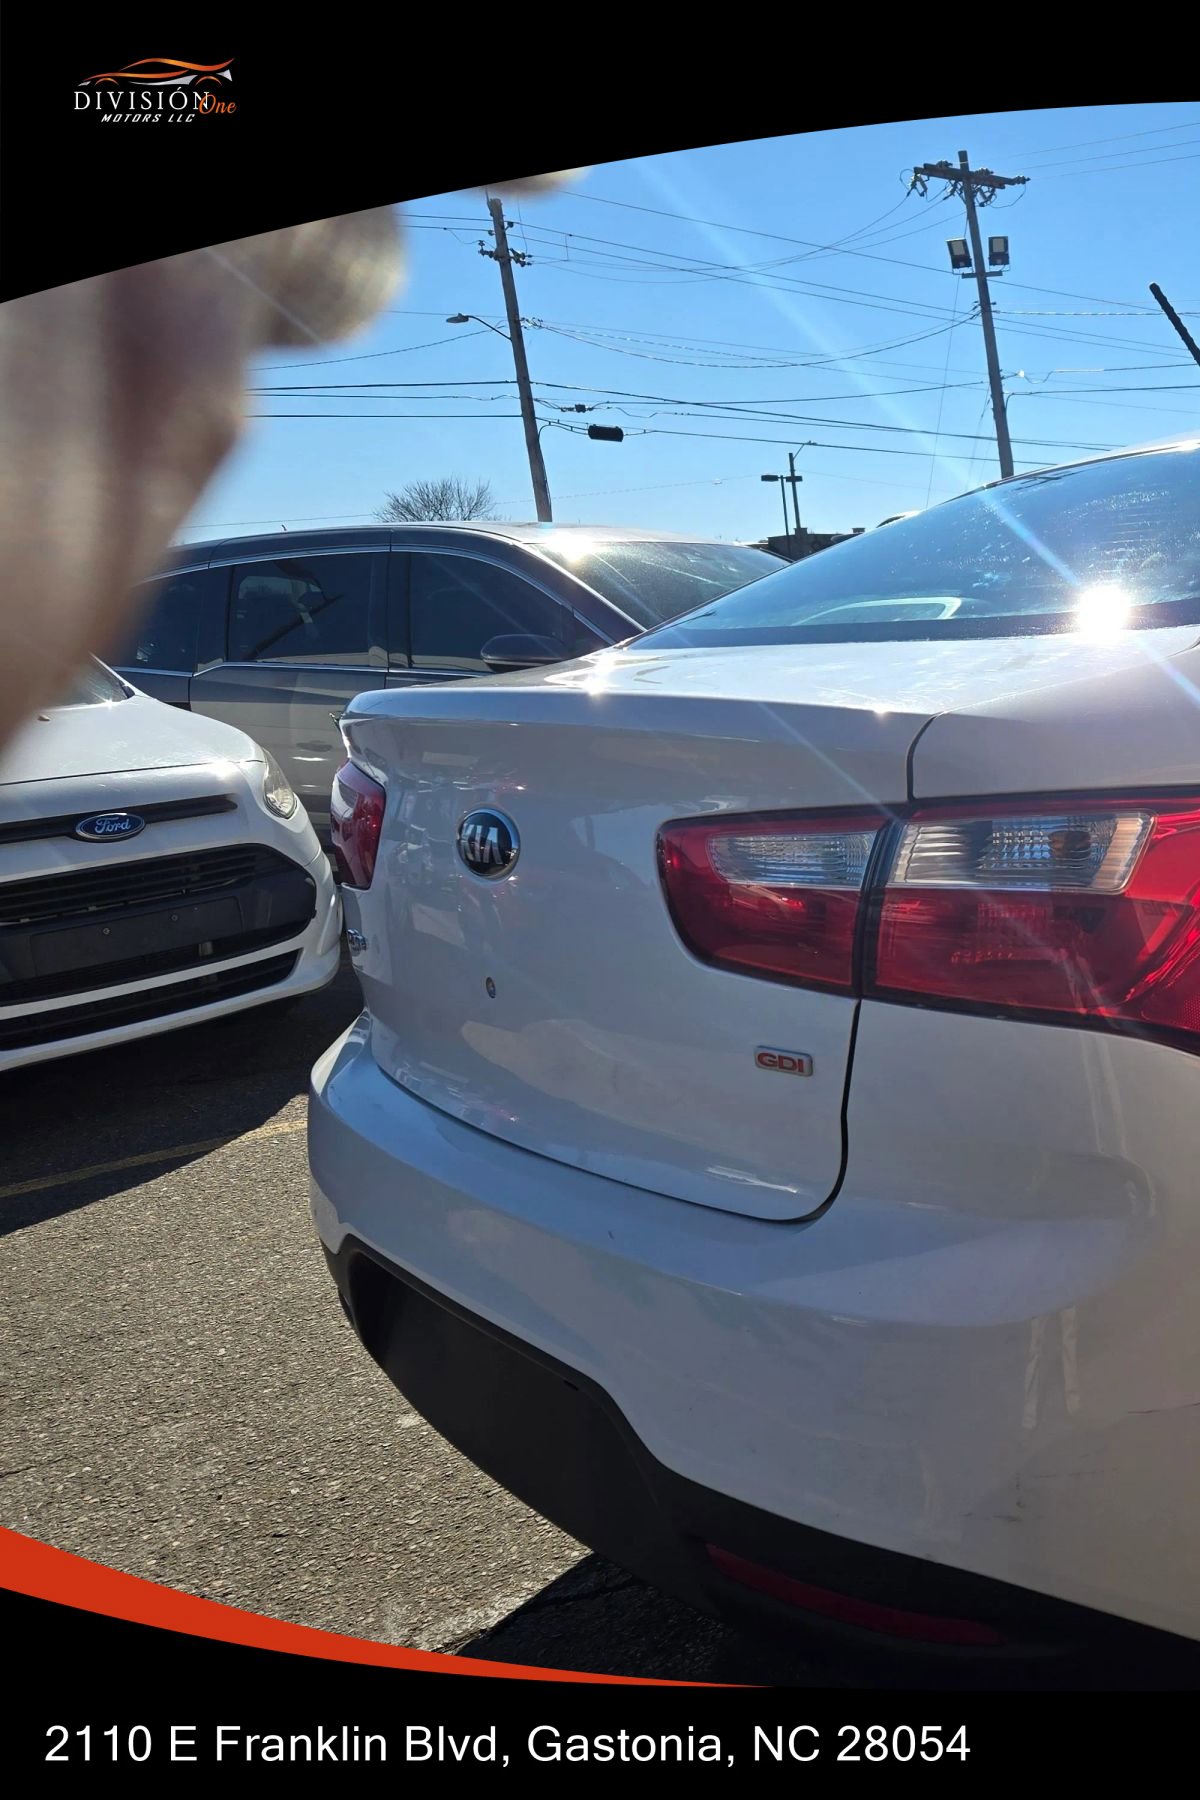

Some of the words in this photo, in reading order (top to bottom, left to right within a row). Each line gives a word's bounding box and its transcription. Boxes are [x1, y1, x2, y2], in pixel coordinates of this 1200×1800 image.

[94, 816, 131, 834] Ford
[461, 823, 503, 865] KIA
[757, 1052, 804, 1073] GDI
